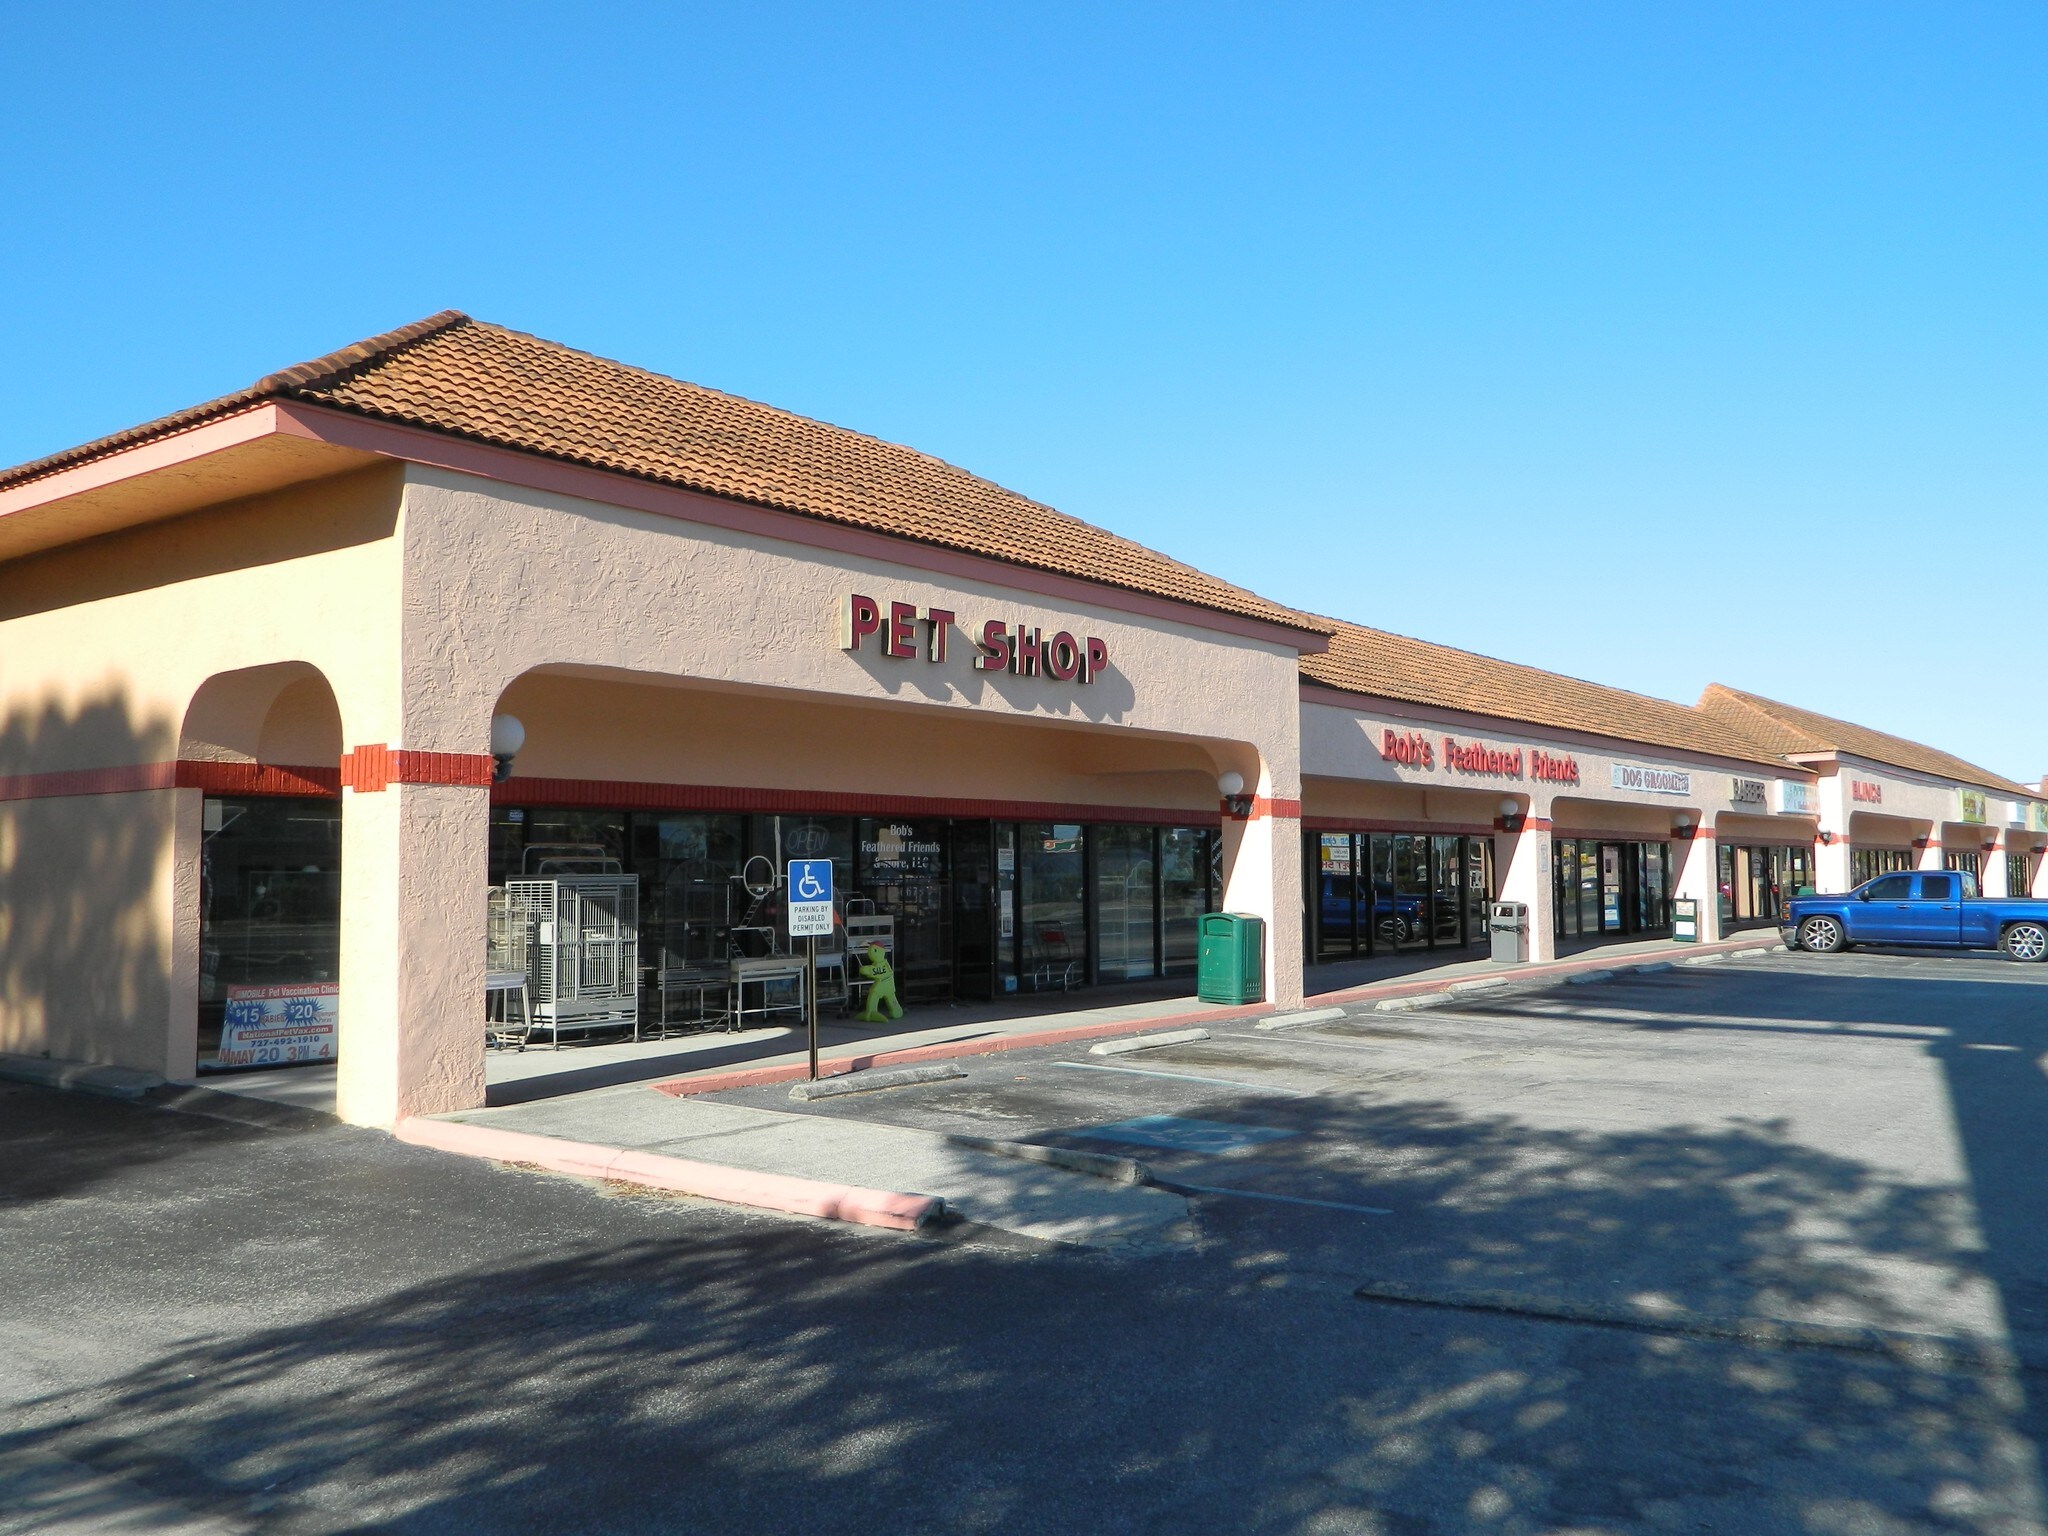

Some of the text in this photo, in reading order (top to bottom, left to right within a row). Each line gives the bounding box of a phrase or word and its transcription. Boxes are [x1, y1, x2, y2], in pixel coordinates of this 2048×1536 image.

[840, 594, 1108, 684] PET SHOP
[1381, 728, 1579, 781] Bob's Feathered Friends
[1622, 767, 1642, 787] DOG
[890, 824, 913, 837] Bob's
[787, 830, 826, 850] OPEN
[861, 840, 941, 853] Feathered Friends
[794, 905, 829, 914] PARKING BY
[797, 914, 825, 922] DISABLED
[793, 924, 813, 932] PERMIT
[241, 989, 266, 998] MOBILE
[268, 988, 280, 996] Pet
[281, 986, 320, 996] Vaccination
[236, 1008, 260, 1023] $15
[290, 1004, 313, 1019] $20
[242, 1026, 329, 1039] NationalPetVax.com
[257, 1046, 280, 1063] 20
